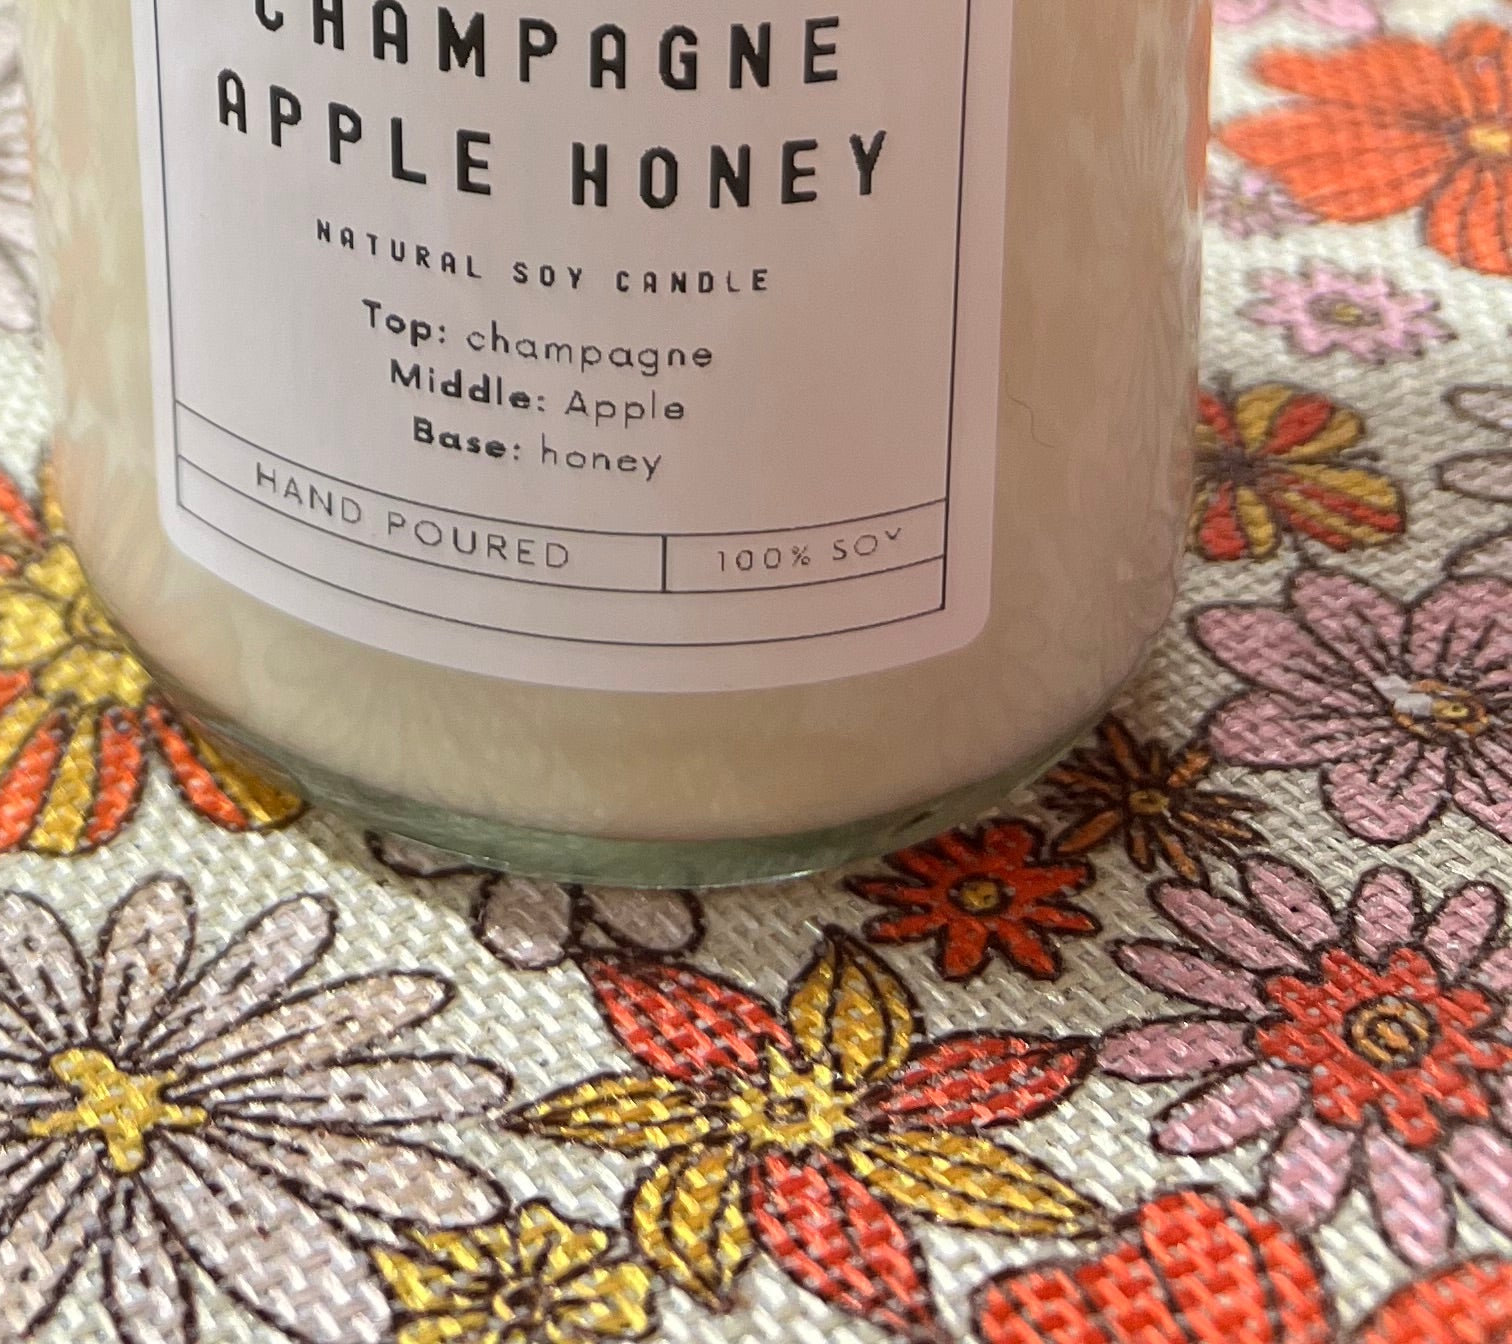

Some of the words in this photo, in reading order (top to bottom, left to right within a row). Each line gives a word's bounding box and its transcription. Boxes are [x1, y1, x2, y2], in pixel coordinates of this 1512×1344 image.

[216, 67, 493, 197] APPLE
[571, 129, 888, 211] HONEY
[316, 217, 483, 280] NATURAL
[512, 260, 583, 291] SOY
[615, 268, 769, 295] CANDLE
[361, 297, 446, 349] Top:
[465, 319, 713, 378] champagne
[390, 357, 546, 413] Middle:
[563, 389, 685, 430] Apple
[413, 415, 522, 462] Base:
[541, 431, 662, 483] honey
[255, 461, 363, 525] HAND
[387, 510, 569, 570] POURED
[717, 544, 812, 573] 100%
[832, 527, 902, 561] SOY
